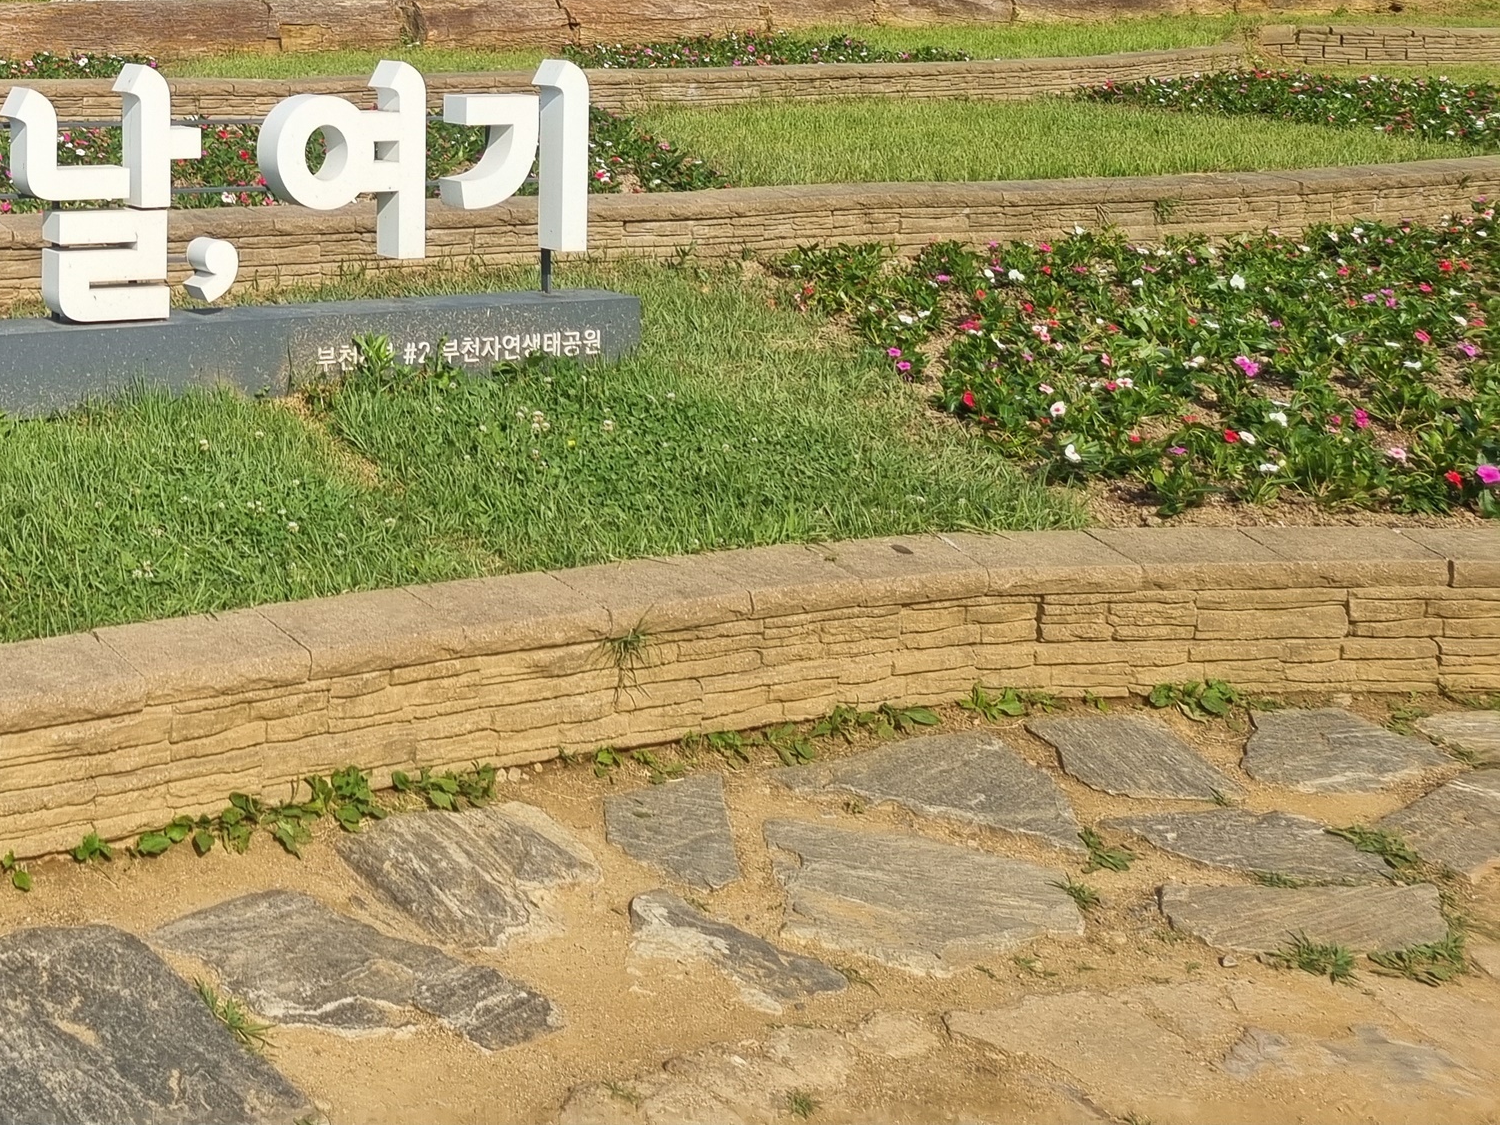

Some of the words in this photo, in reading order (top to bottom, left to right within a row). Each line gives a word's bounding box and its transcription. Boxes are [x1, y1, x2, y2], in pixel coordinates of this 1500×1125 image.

[257, 59, 589, 259] 여기
[316, 342, 394, 372] 부천
[403, 341, 430, 365] #2
